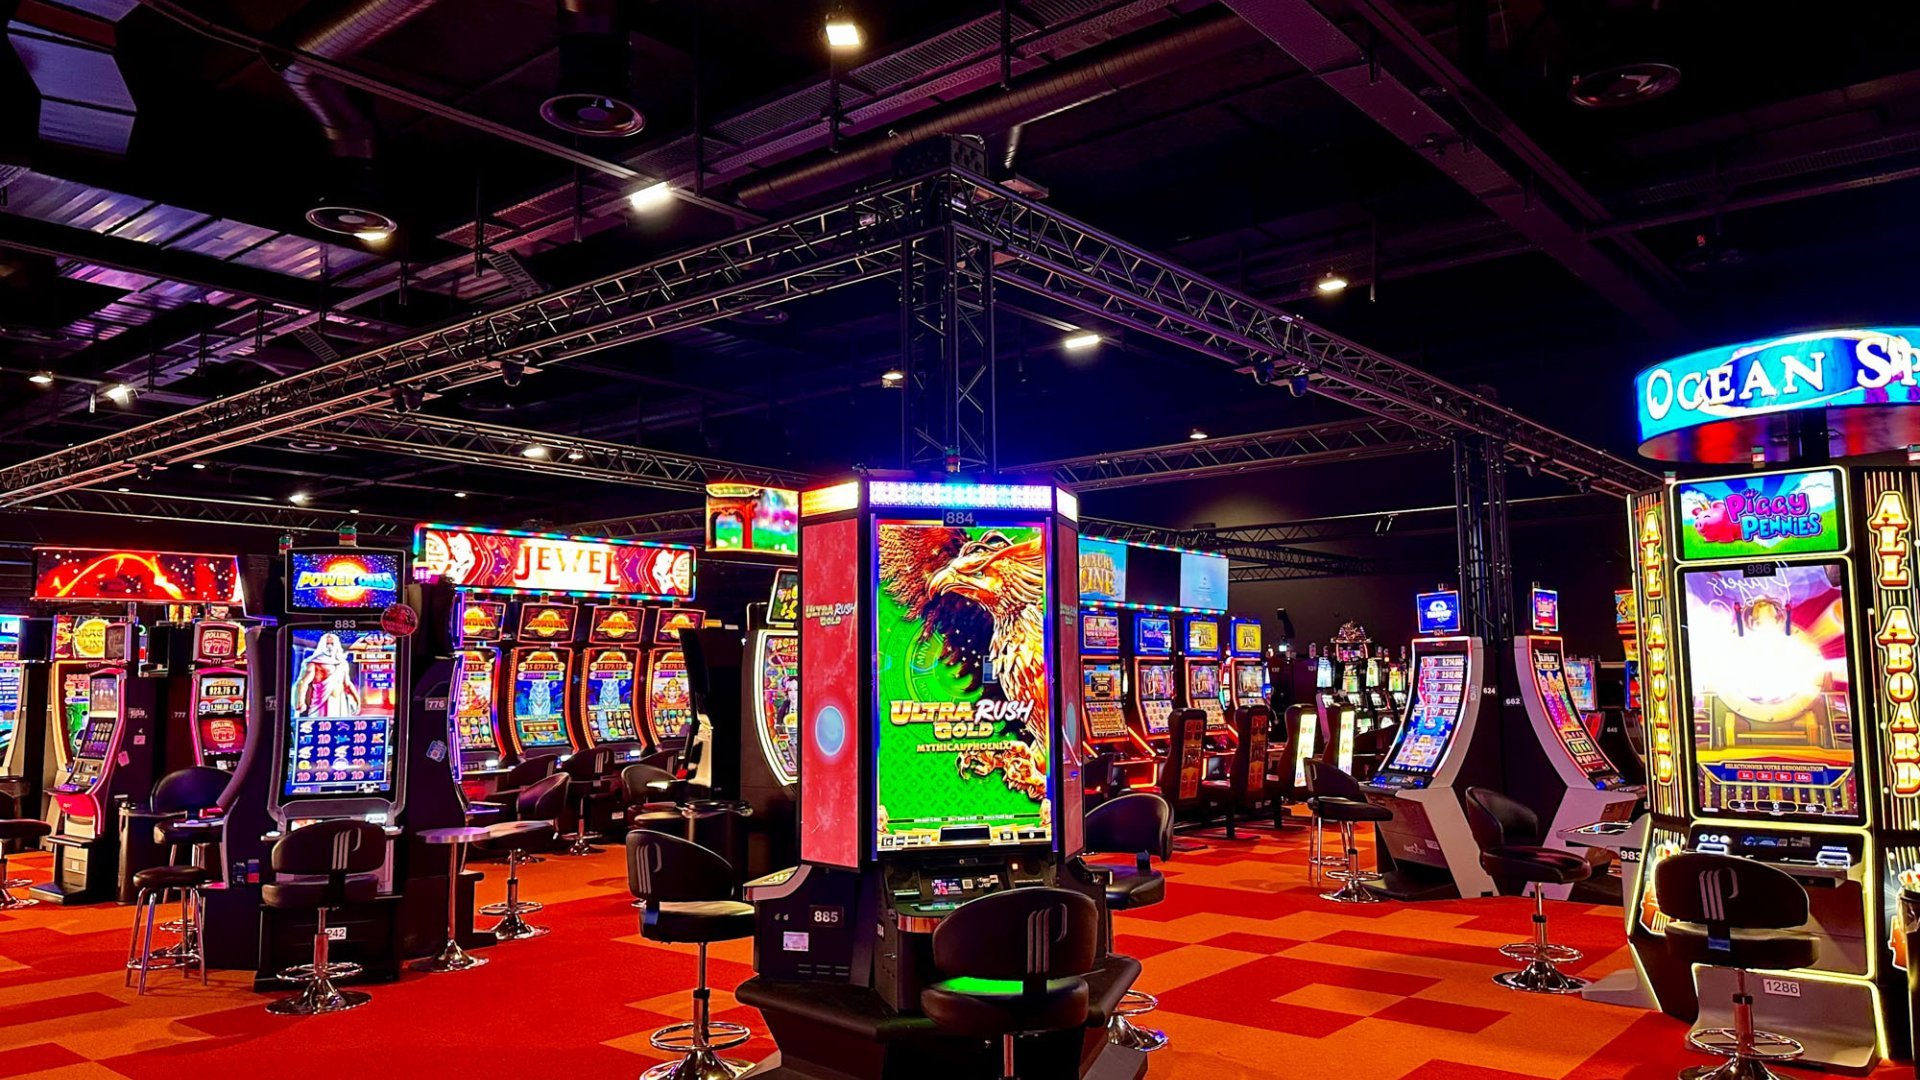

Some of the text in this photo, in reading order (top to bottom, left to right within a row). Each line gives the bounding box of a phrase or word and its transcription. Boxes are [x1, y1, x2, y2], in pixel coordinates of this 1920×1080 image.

[1646, 352, 1826, 420] OCEAN
[945, 511, 974, 524] 884
[514, 545, 620, 585] JEWEL
[1747, 563, 1771, 575] 986
[299, 572, 357, 588] POWER
[805, 604, 834, 618] ULTRA
[335, 619, 356, 629] 883
[1867, 491, 1920, 797] ALL ABOARD
[916, 641, 932, 665] MINI
[1483, 687, 1496, 695] 624
[428, 700, 445, 709] 776
[1505, 698, 1521, 706] 662
[890, 699, 1035, 726] ULTRA RUSH
[934, 722, 994, 740] GOLD
[1620, 850, 1641, 861] 983
[814, 910, 839, 923] 885
[1766, 981, 1799, 994] 1286
